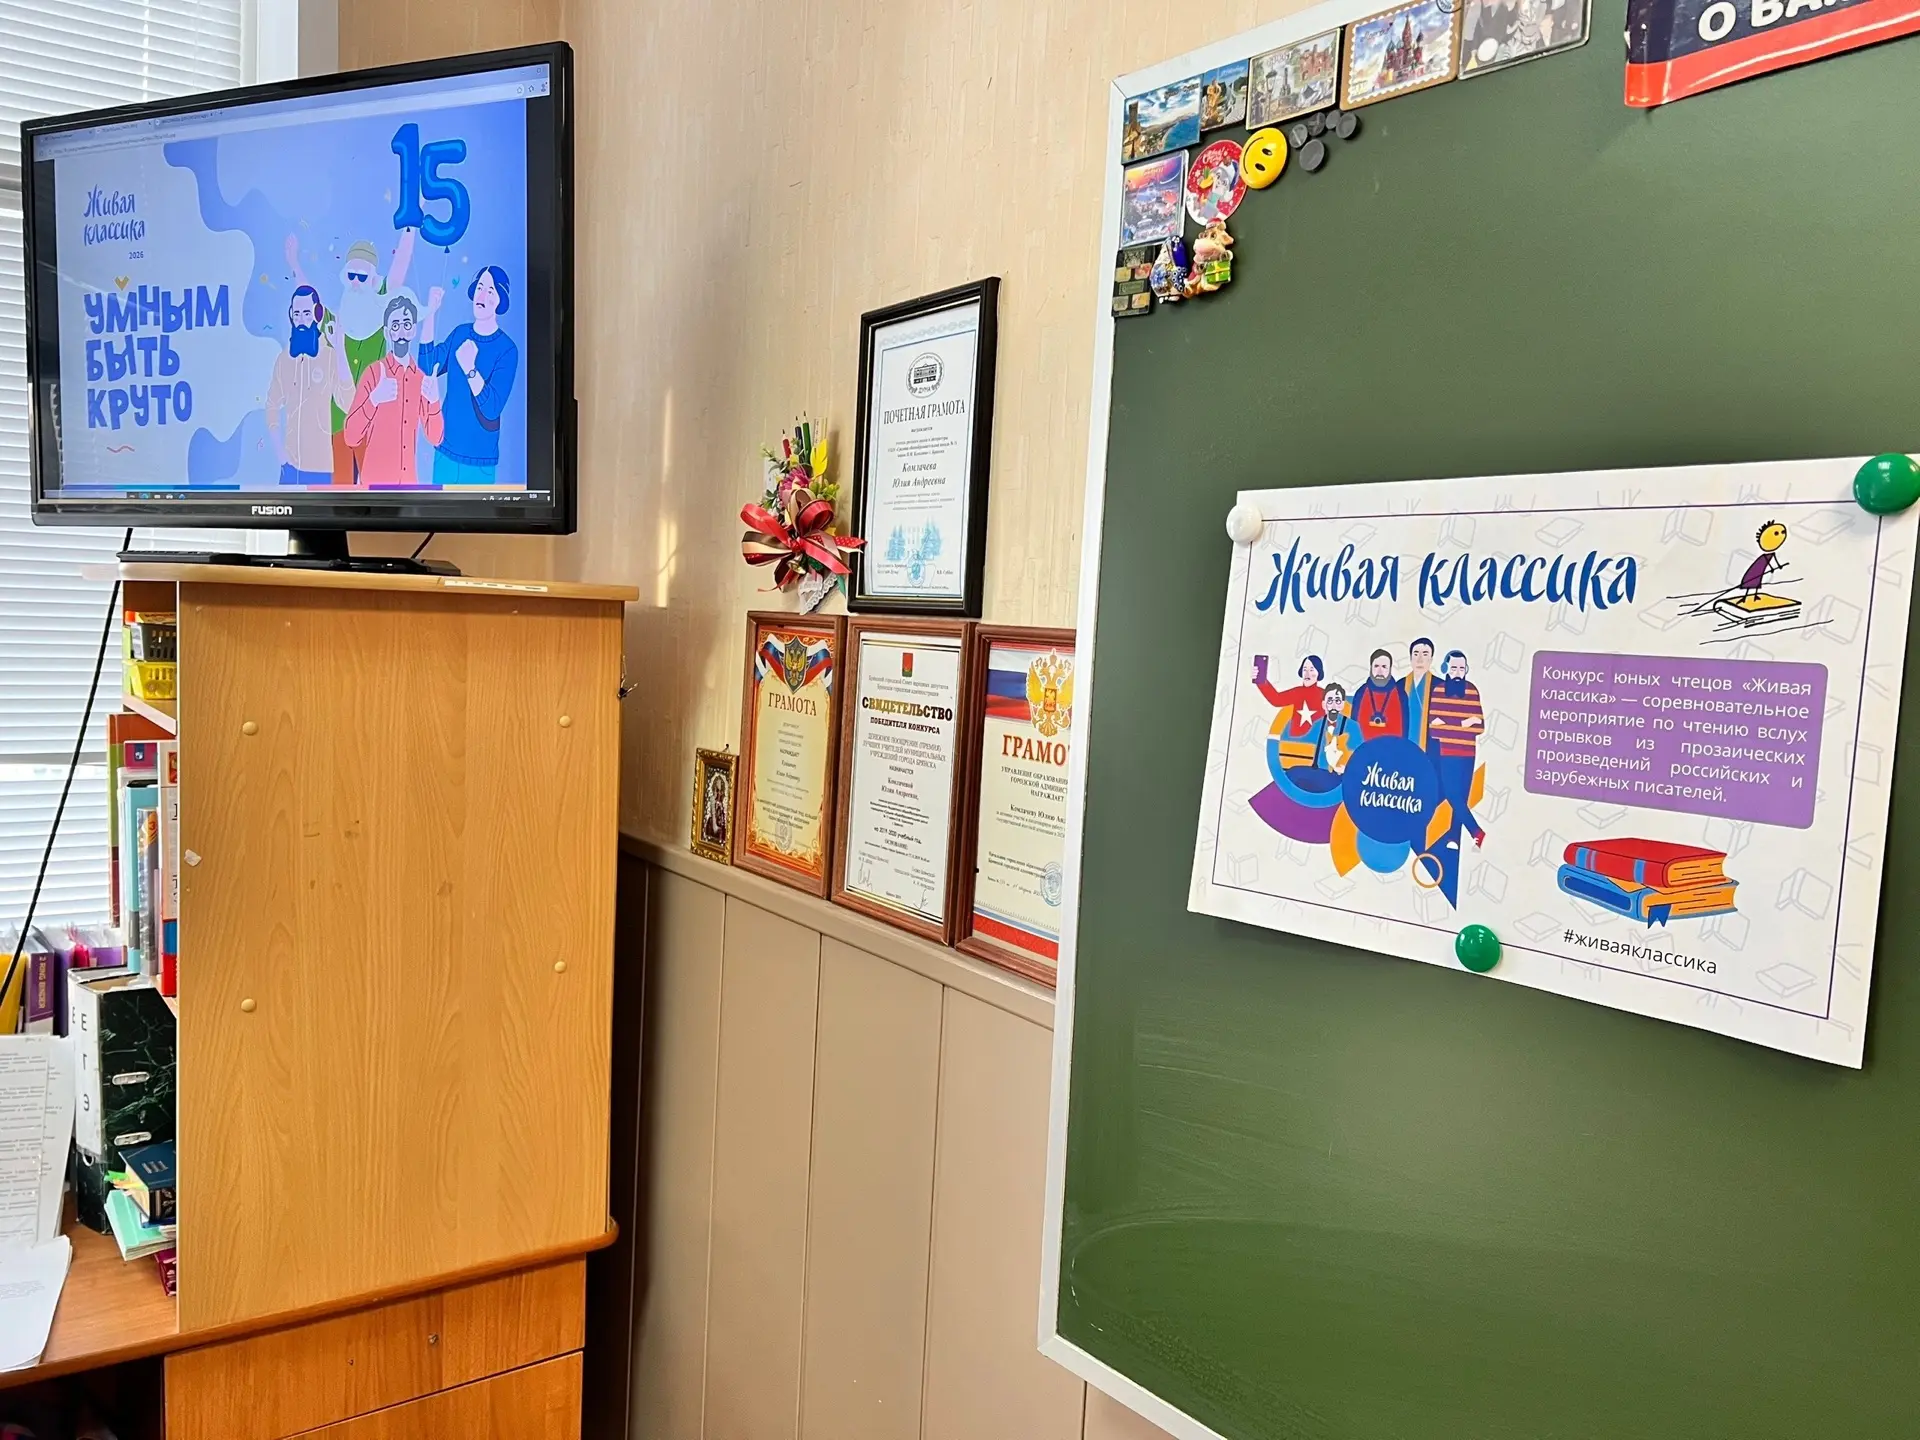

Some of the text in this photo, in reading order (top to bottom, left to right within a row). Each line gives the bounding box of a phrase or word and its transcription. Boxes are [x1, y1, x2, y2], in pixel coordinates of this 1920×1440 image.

[1698, 2, 1737, 41] О
[84, 184, 135, 217] Живая
[391, 123, 470, 246] 15
[84, 219, 145, 246] классика
[129, 251, 144, 259] 2026
[84, 284, 229, 334] УМНЫМ
[85, 334, 180, 382] БЫТЬ
[87, 381, 192, 430] КРУТО
[884, 399, 965, 424] ПОЧЕТНАЯ ГРАМОТА
[892, 478, 911, 488] Юлия
[251, 505, 293, 515] FUSION
[1255, 535, 1637, 615] Живая классика
[1542, 666, 1811, 695] Конкурс юных чтецов «Живая
[768, 692, 817, 716] ГРАМОТА
[862, 696, 953, 721] СВИДЕТЕЛЬСТВО
[1540, 688, 1616, 704] классика»
[1642, 696, 1810, 719] соревновательное
[870, 716, 941, 735] ПОБЕДИТЕЛЯ КОНКУРСА
[1539, 709, 1808, 745] мероприятие по чтению вслух
[1002, 734, 1070, 766] ГРАМО
[1538, 729, 1806, 766] отрывков из прозаических
[1361, 761, 1415, 792] Живая
[1536, 749, 1803, 788] произведений российских и
[1360, 789, 1422, 814] классика
[1535, 769, 1727, 802] зарубежных писателей.
[1563, 929, 1717, 974] #живаяклассика
